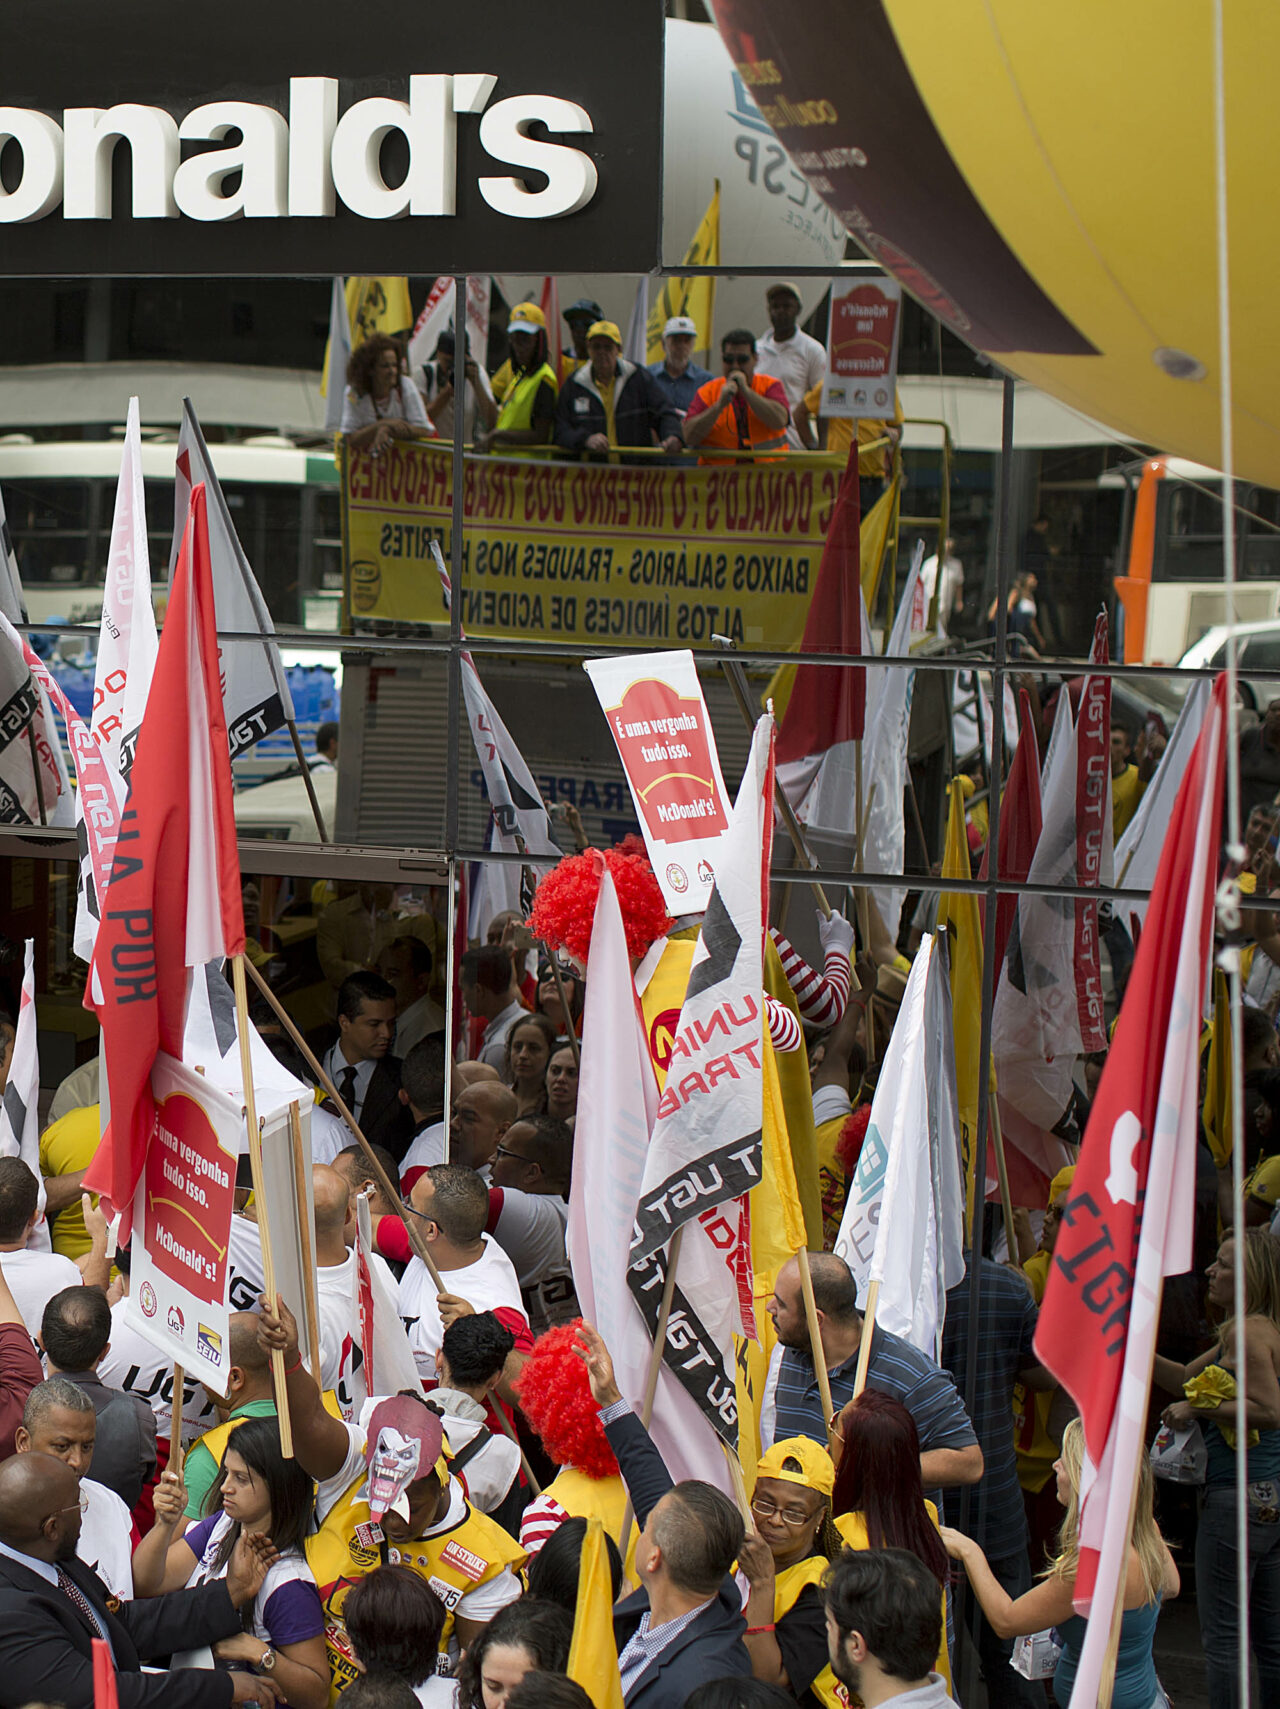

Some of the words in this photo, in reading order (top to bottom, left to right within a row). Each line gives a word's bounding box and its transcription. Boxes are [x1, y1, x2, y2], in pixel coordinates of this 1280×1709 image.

[615, 716, 626, 739] É
[625, 719, 652, 738] uma
[649, 711, 699, 737] vergonha
[640, 743, 668, 764] tudo
[665, 740, 693, 761] isso.
[1085, 755, 1106, 826] UGT
[656, 798, 718, 823] McDonald's!
[159, 1121, 180, 1152] uma
[179, 1138, 230, 1190] vergonha
[162, 1157, 186, 1191] tudo
[184, 1172, 210, 1210] isso.
[154, 1221, 217, 1284] McDonald's!
[167, 1316, 186, 1336] UGT
[197, 1340, 222, 1368] SEIU
[705, 1375, 739, 1426] UG
[446, 1541, 458, 1555] ON
[456, 1547, 488, 1573] STRIKE
[444, 1589, 460, 1608] 15
[336, 1656, 361, 1679] VER
